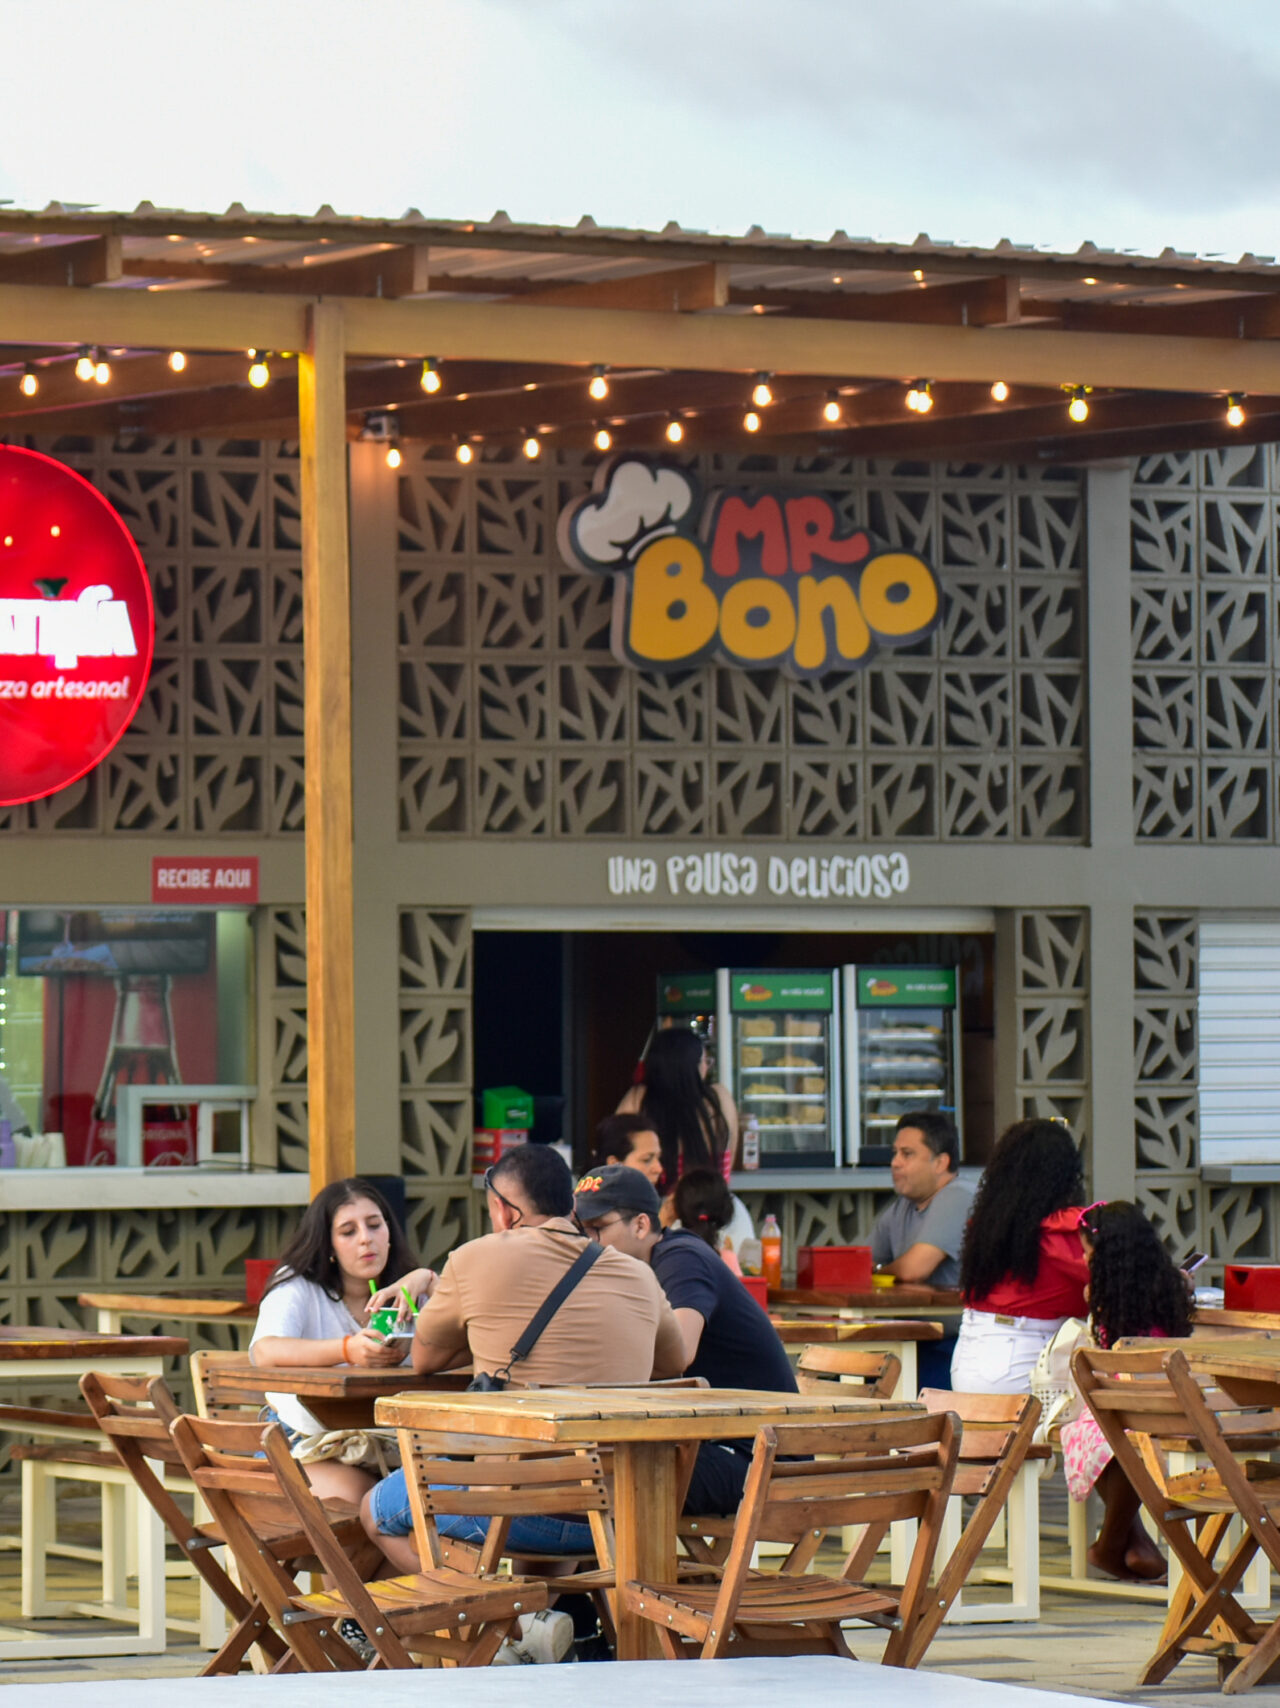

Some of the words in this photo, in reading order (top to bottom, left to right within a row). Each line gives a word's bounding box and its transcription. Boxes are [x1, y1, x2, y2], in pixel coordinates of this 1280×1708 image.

[711, 494, 871, 577] MR
[31, 675, 130, 699] artesanal
[157, 868, 211, 889] RECIBE
[214, 868, 251, 889] AQUI
